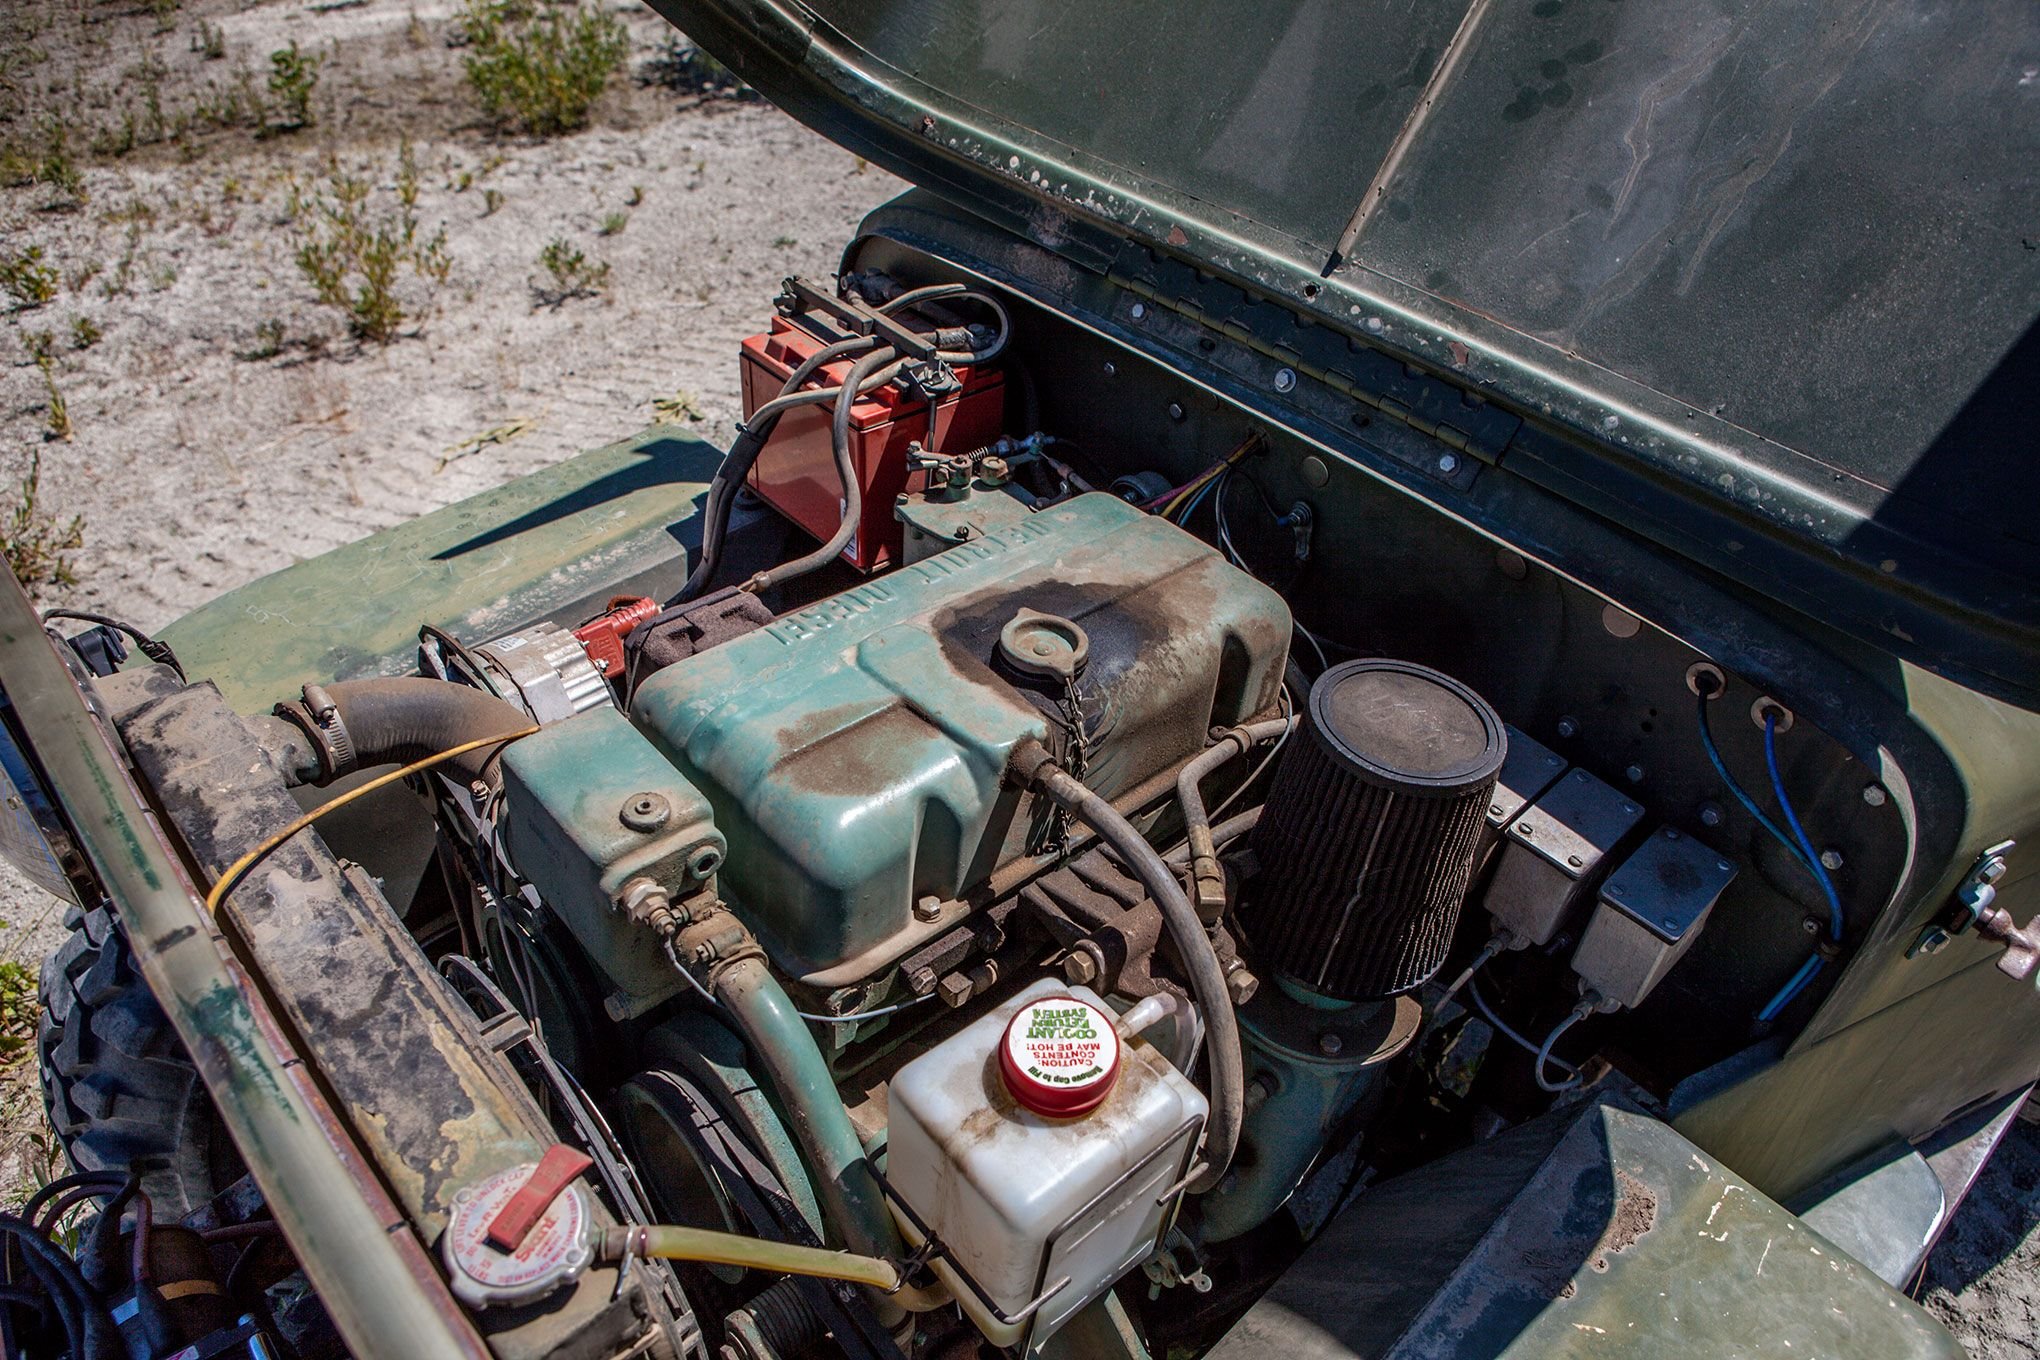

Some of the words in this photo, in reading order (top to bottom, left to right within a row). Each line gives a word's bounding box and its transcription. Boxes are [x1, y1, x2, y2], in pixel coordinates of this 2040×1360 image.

[763, 582, 896, 646] DIESEL
[1032, 1008, 1087, 1019] SYSTEM
[1032, 1018, 1089, 1029] RETURN
[1026, 1028, 1097, 1039] COOLANT
[1028, 1066, 1042, 1078] Fill
[1072, 1066, 1103, 1082] Remove
[1042, 1074, 1052, 1082] to
[1053, 1075, 1070, 1084] Cap
